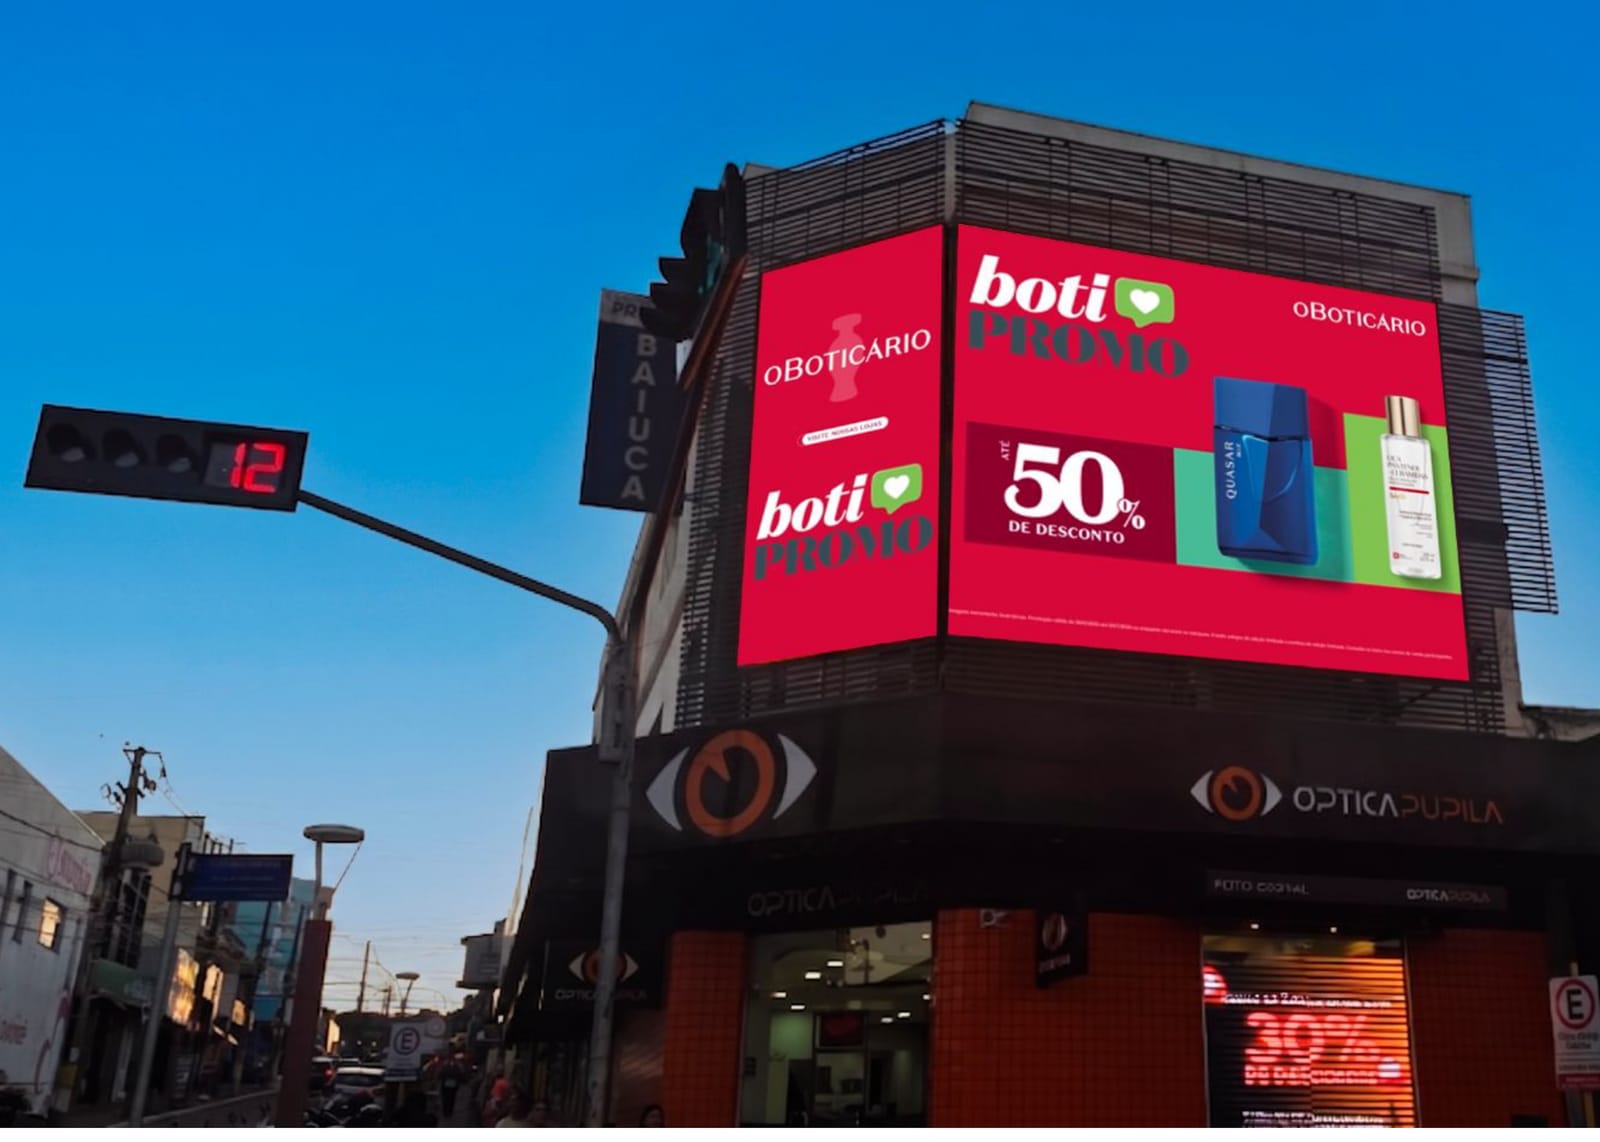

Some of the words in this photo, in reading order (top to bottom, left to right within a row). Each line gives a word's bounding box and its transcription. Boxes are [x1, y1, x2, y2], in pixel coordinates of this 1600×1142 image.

[611, 301, 639, 318] PR
[969, 254, 1110, 322] boti
[968, 309, 1190, 379] PROMO
[621, 333, 657, 500] BAIUCA
[229, 443, 286, 493] 12
[1004, 443, 1146, 529] 50%
[1224, 441, 1237, 500] QUASAR
[756, 473, 868, 541] boti
[1008, 520, 1031, 534] DE
[1036, 522, 1125, 544] DESCONTO
[753, 514, 933, 582] PROMO
[1566, 989, 1584, 1020] E
[401, 1032, 413, 1050] E
